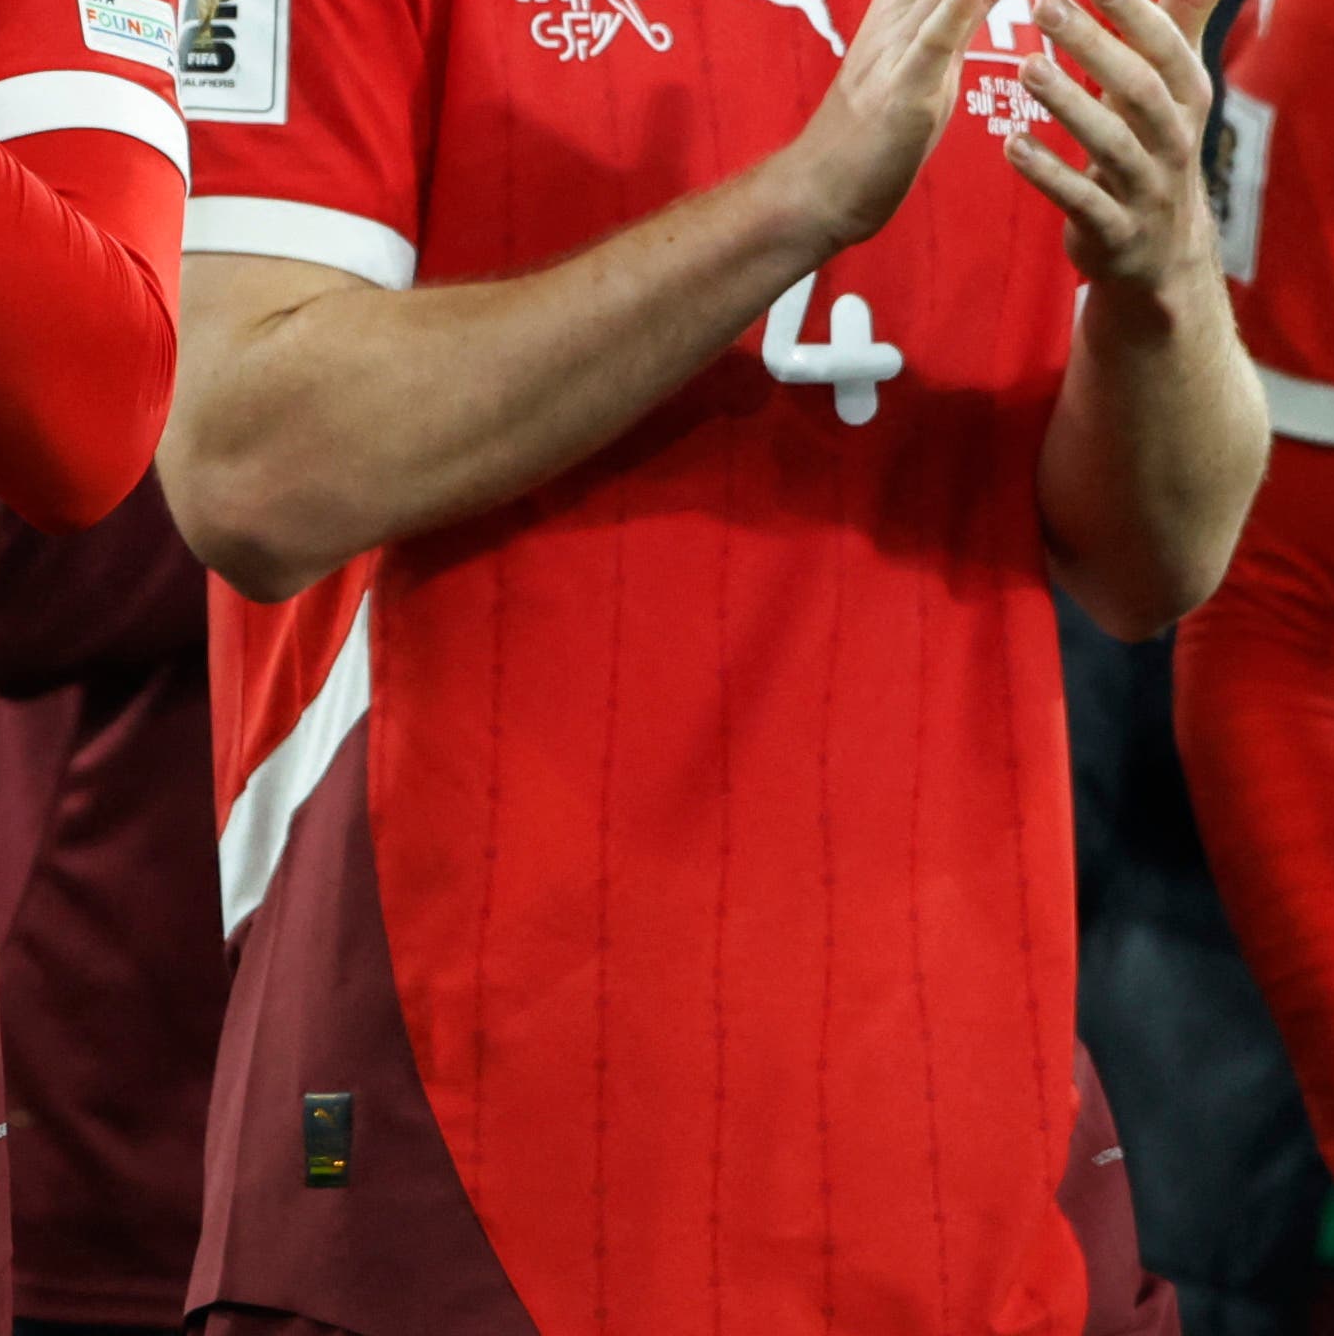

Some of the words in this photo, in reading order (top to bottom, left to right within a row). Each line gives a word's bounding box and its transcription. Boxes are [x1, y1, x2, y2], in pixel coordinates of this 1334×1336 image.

[86, 7, 175, 45] FOUNDAT
[187, 52, 218, 66] FIFA
[181, 77, 236, 89] ALIFIERS
[966, 90, 994, 116] SUI
[762, 269, 903, 425] 4
